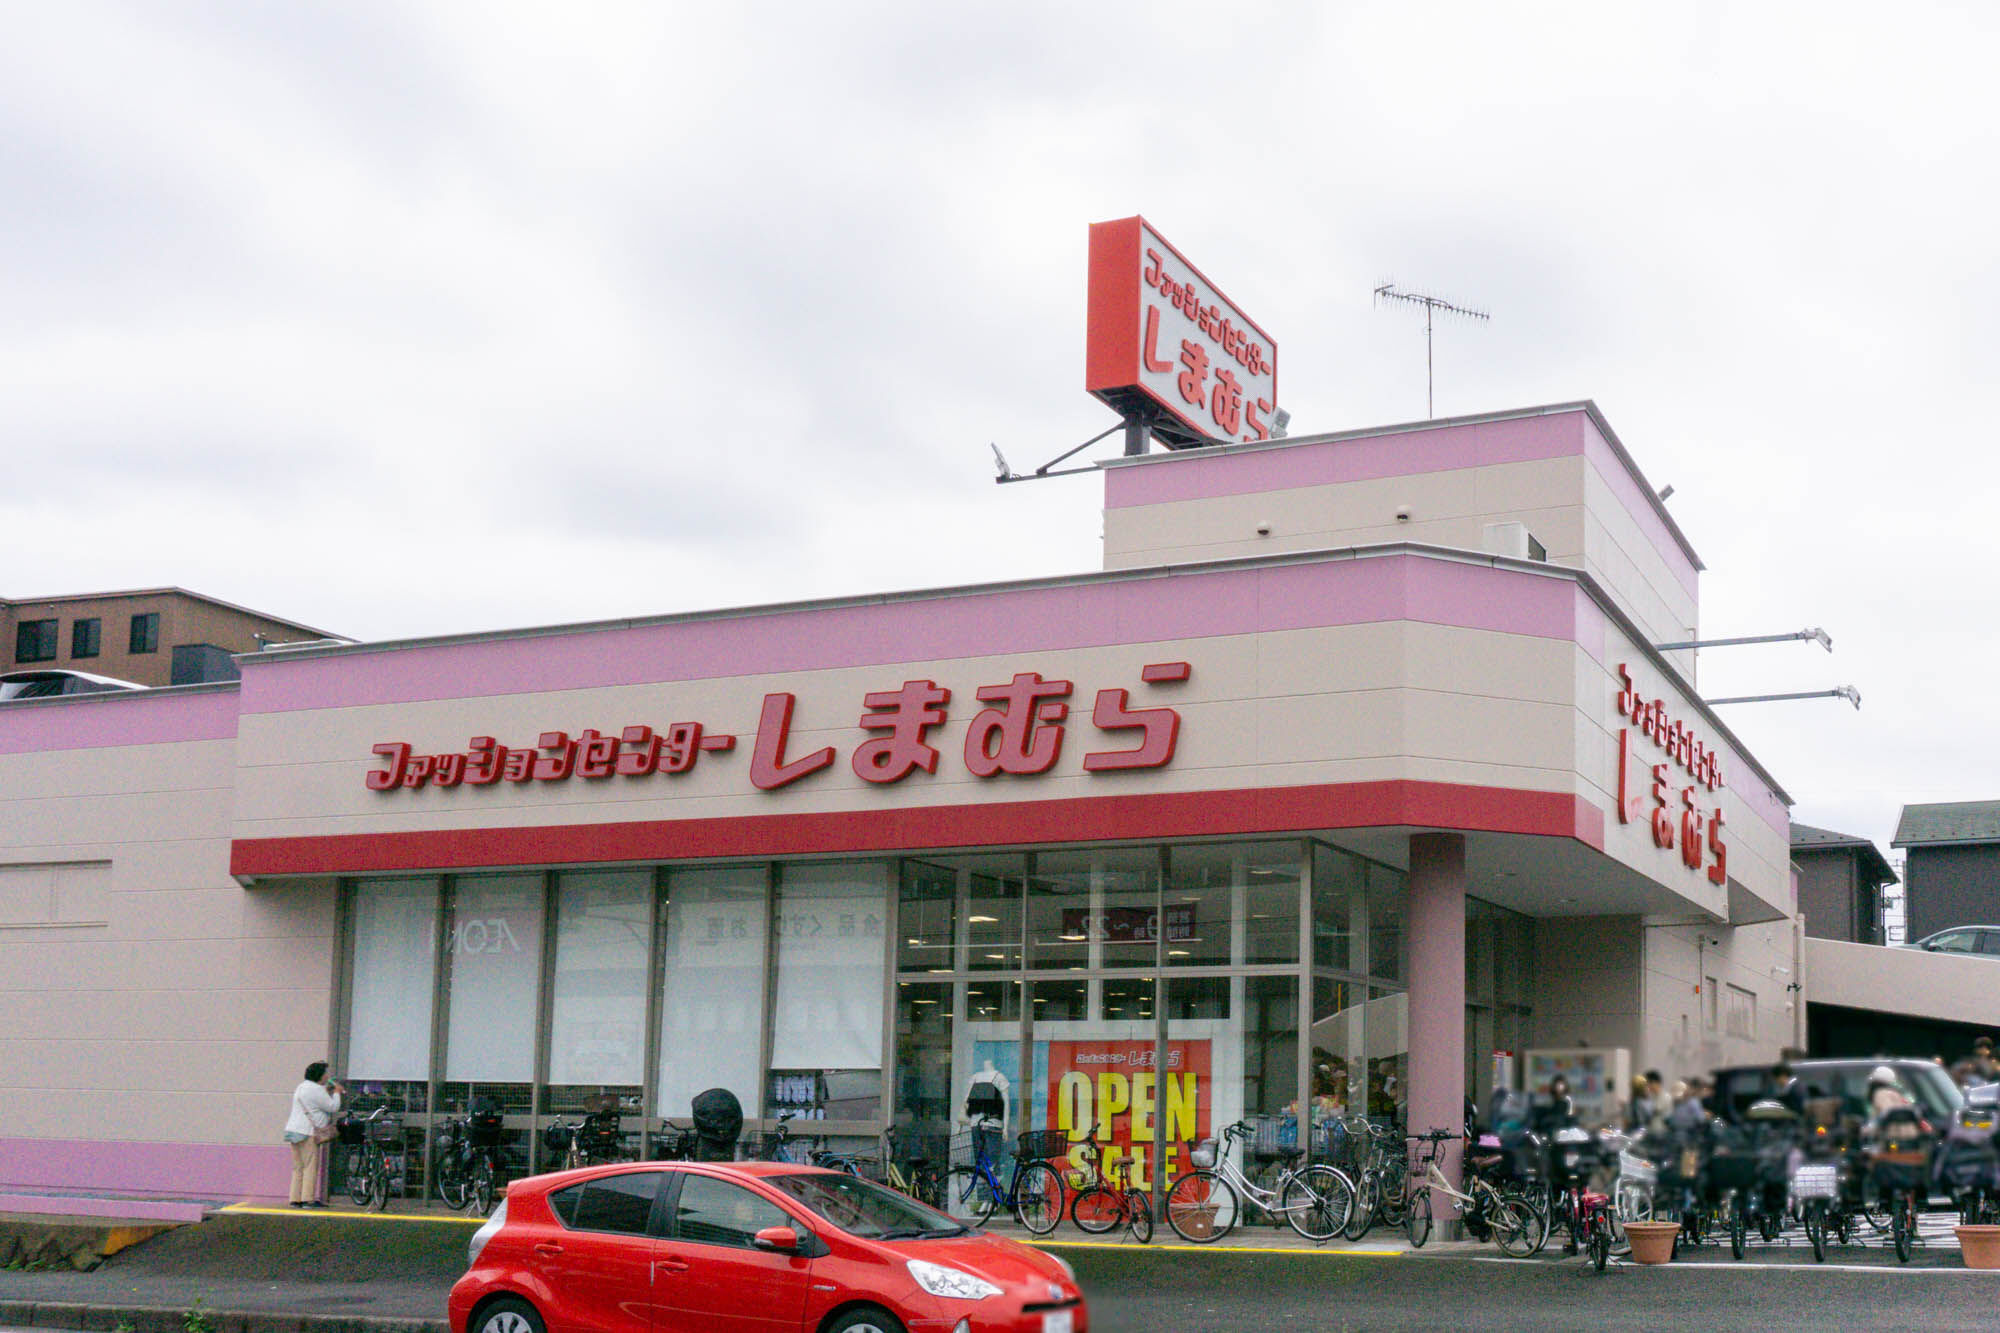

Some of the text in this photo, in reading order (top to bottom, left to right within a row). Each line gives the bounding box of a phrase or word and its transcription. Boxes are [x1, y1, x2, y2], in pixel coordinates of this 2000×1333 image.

[1144, 304, 1271, 442] しまむら
[1145, 247, 1271, 376] ファッションセンター
[366, 661, 1191, 791] ファッションセンター しまむら
[1618, 728, 1726, 885] しまむら
[1057, 1070, 1198, 1144] OPEN
